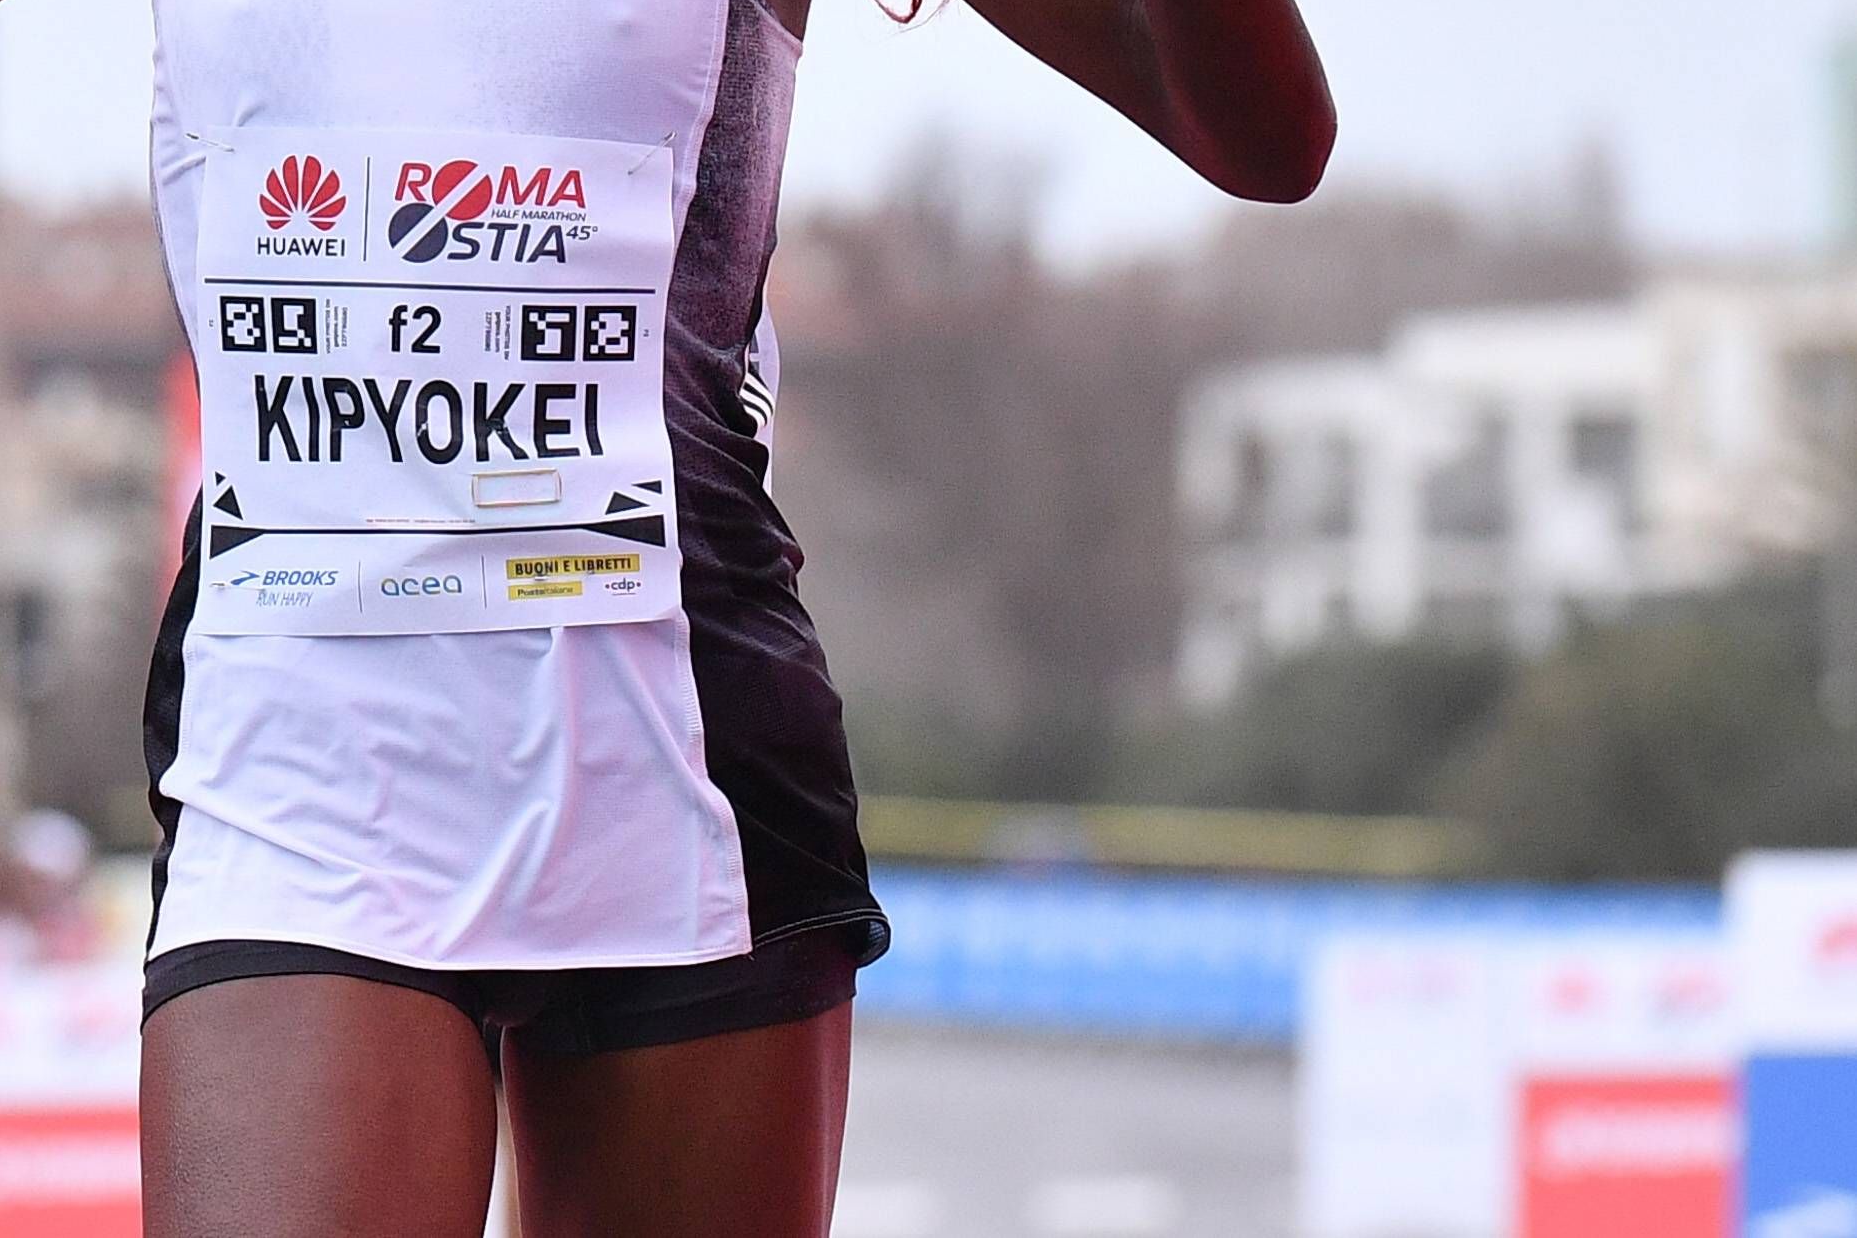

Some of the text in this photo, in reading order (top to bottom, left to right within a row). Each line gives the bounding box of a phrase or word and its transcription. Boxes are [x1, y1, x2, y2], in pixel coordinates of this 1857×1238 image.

[491, 208, 587, 222] HALF MARATHON
[257, 236, 346, 257] HUAWEI
[388, 304, 442, 355] f2
[254, 374, 604, 465] KIPYOKEI
[515, 557, 631, 576] BUONI E LIBRETTI
[262, 570, 339, 587] BROOKS
[381, 575, 462, 596] acea
[256, 591, 314, 608] RUN HAPPY
